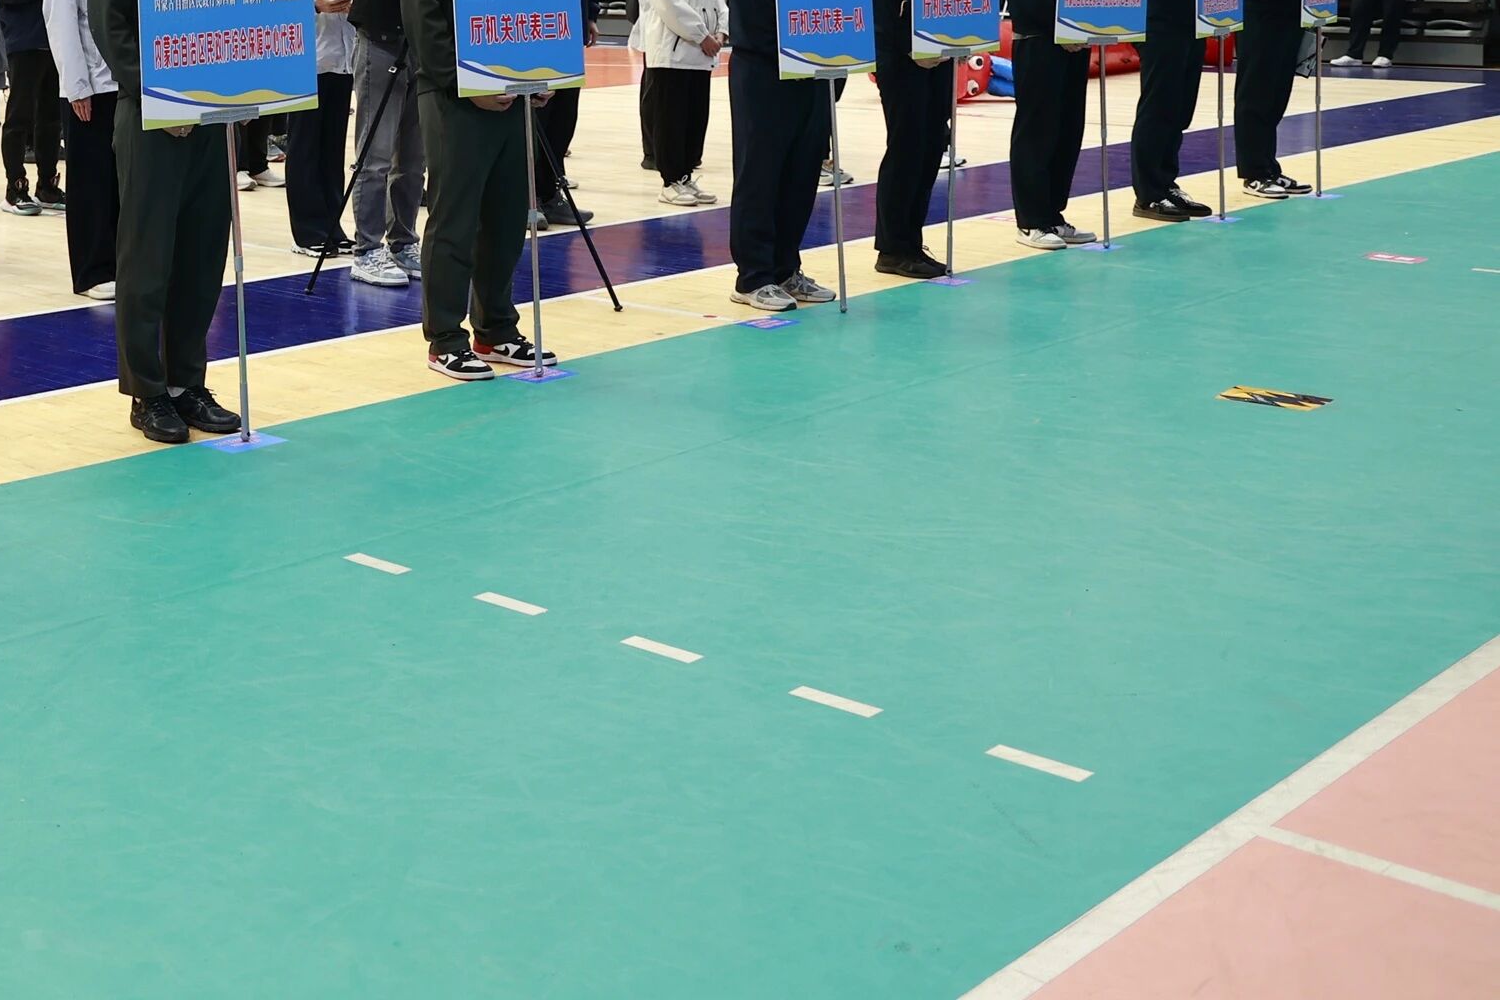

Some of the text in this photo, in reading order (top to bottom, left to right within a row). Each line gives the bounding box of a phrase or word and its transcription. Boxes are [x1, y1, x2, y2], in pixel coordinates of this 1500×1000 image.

[470, 10, 571, 46] 厅机关代表三队
[787, 6, 866, 36] 厅机关代表一队
